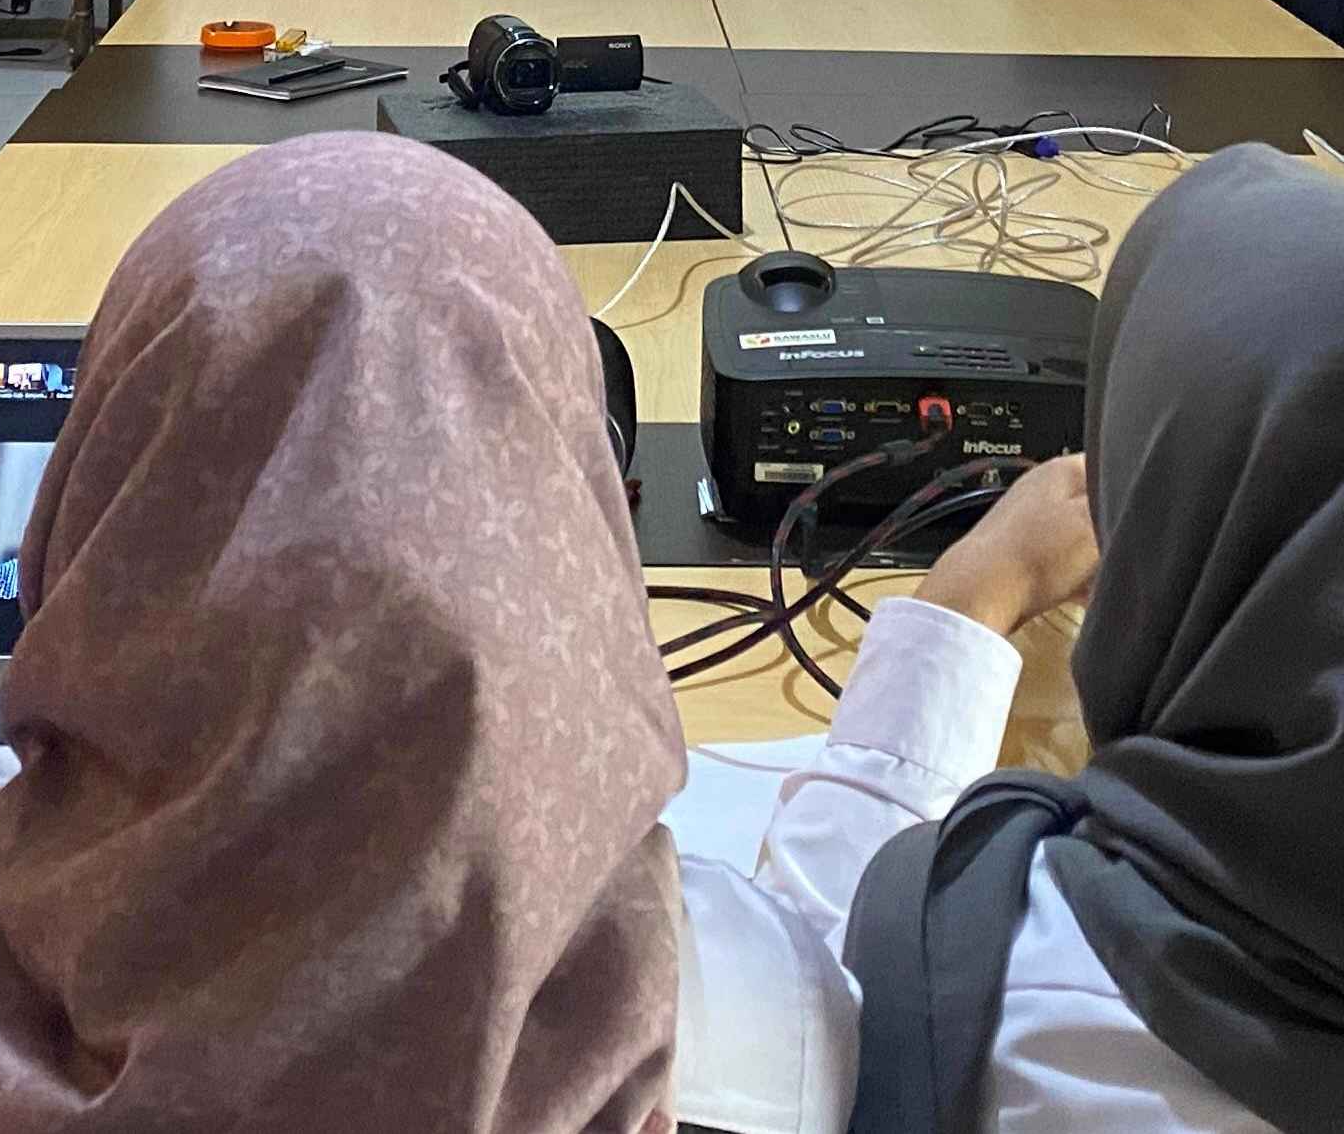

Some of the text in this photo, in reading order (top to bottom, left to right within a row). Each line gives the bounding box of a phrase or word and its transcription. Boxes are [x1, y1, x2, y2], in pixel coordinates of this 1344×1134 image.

[608, 42, 632, 50] SONY
[773, 333, 831, 343] BAWASLU
[779, 349, 865, 361] InFocus
[963, 440, 1022, 455] InFocus
